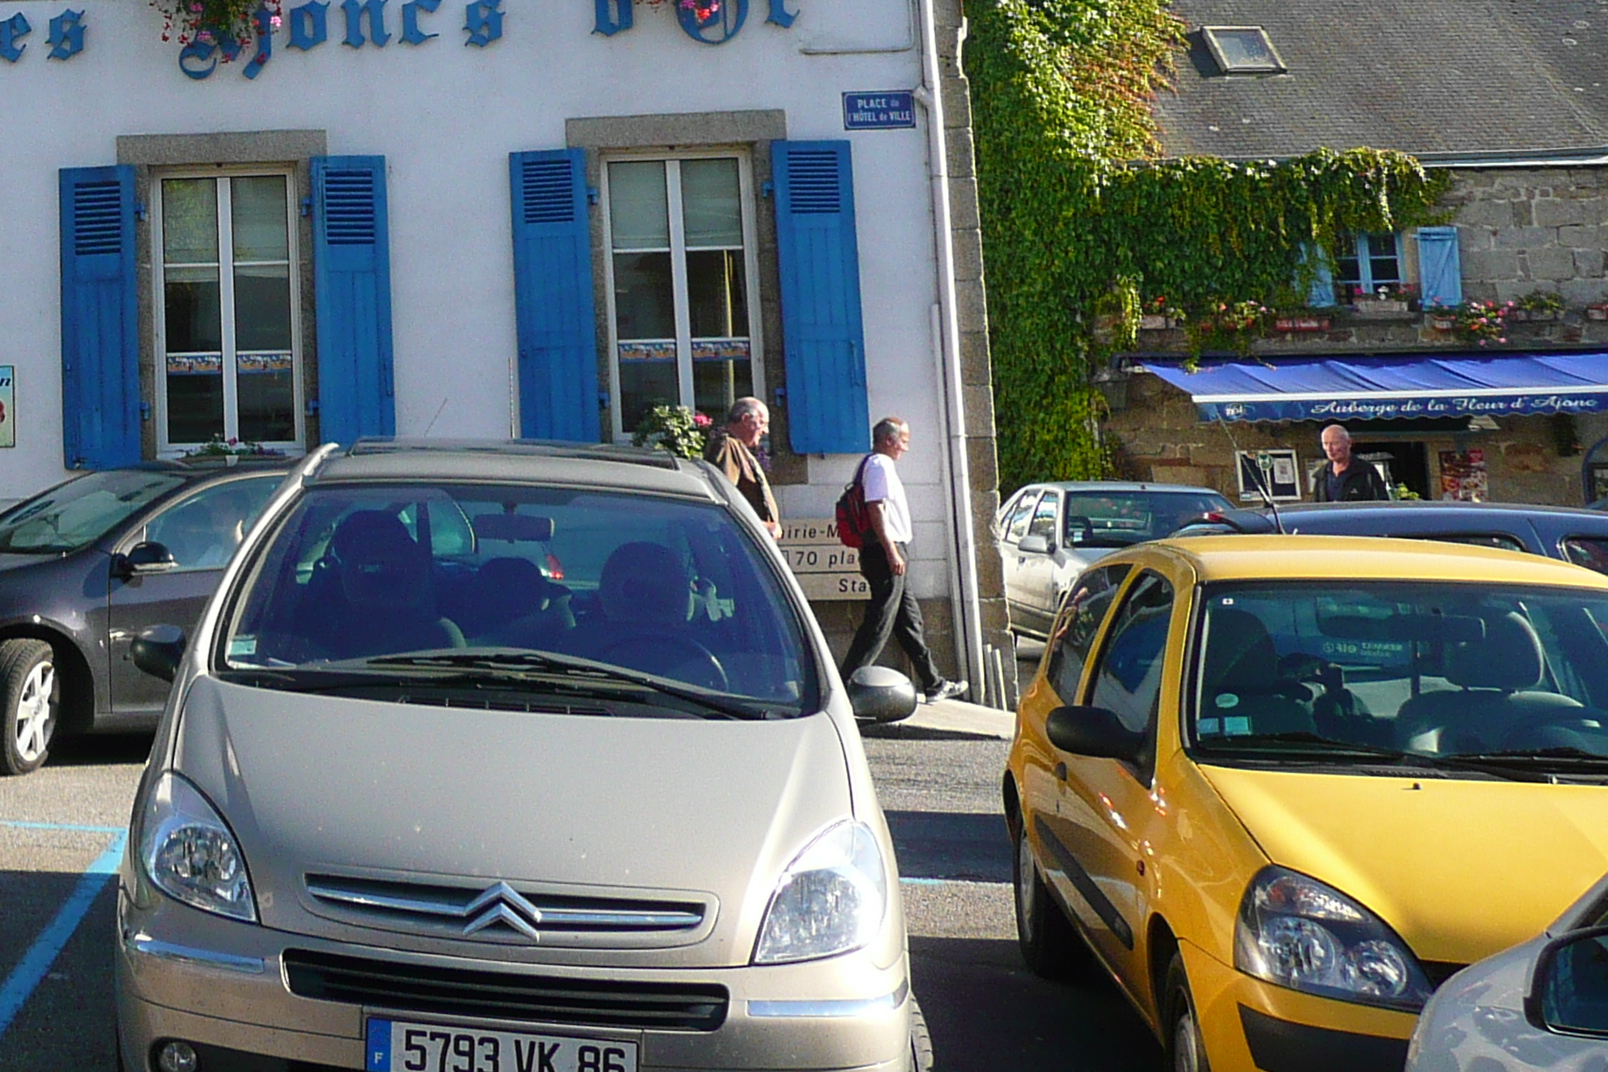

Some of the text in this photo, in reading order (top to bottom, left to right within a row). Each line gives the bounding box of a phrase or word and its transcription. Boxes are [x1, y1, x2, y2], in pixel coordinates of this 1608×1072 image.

[857, 98, 887, 108] PLACE
[889, 110, 910, 121] VILLE
[1311, 401, 1397, 416] Auberge
[1400, 399, 1422, 412] de
[1427, 399, 1448, 412] la
[1452, 397, 1507, 411] Fleur
[795, 550, 856, 569] 70 pla
[838, 578, 867, 593] Sta
[374, 1051, 384, 1065] F
[404, 1029, 625, 1072] 5793 VK 86
